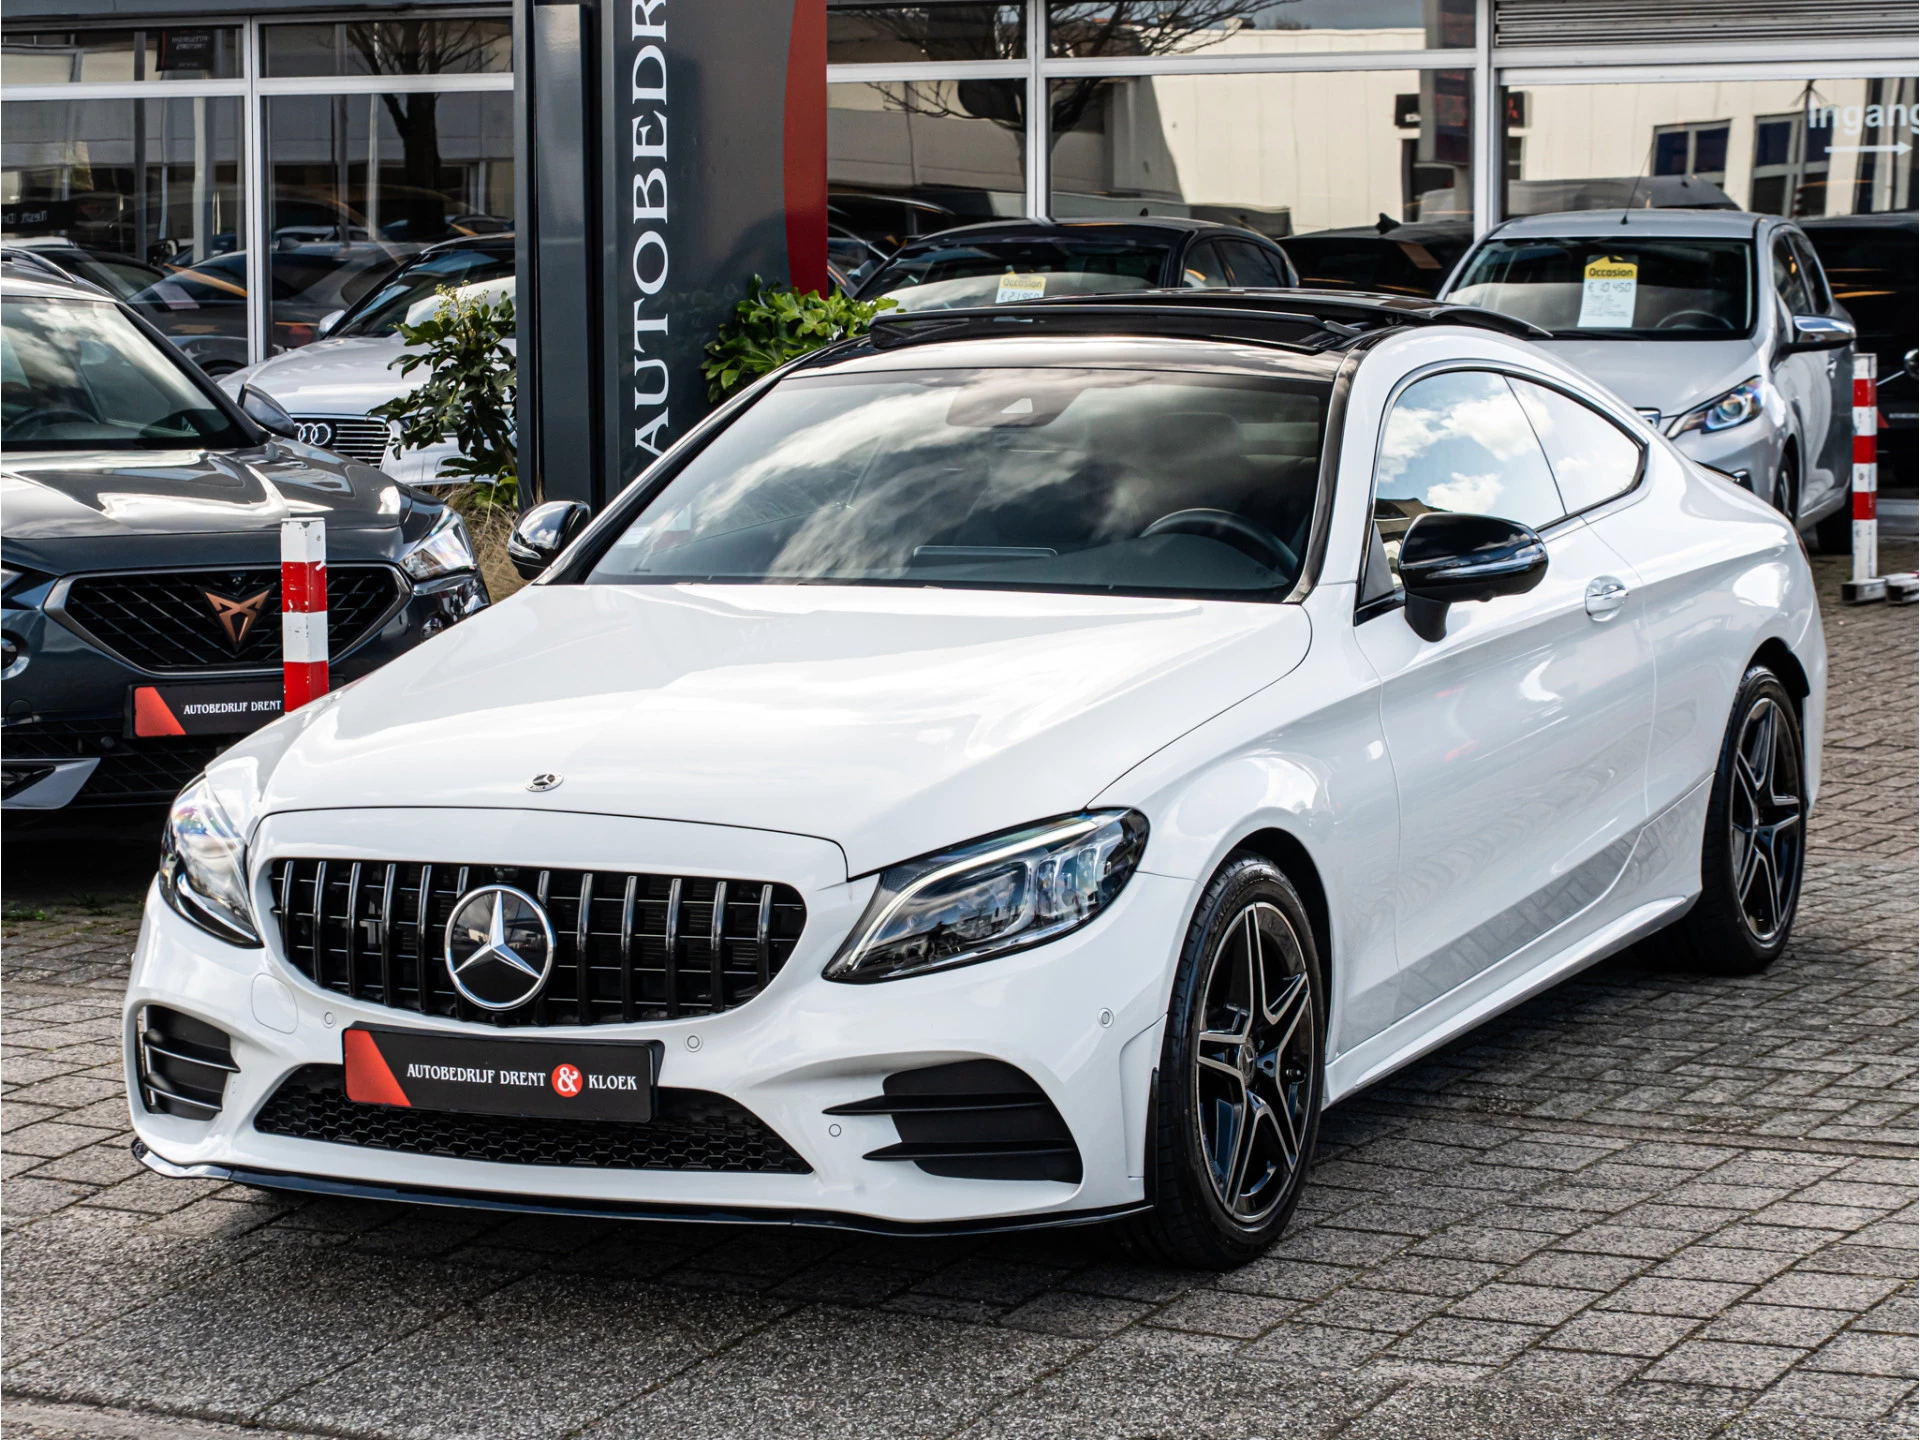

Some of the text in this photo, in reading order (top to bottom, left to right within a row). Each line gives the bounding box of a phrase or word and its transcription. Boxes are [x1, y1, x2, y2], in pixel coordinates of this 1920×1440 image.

[632, 0, 669, 457] AUTOBEDR
[1588, 267, 1634, 277] Occasion
[1003, 278, 1043, 288] Occasion
[183, 700, 282, 715] AUTOBEDRIJF DRENT
[406, 1063, 638, 1092] AUTOBEDRIJF DRENT & KLOEK
